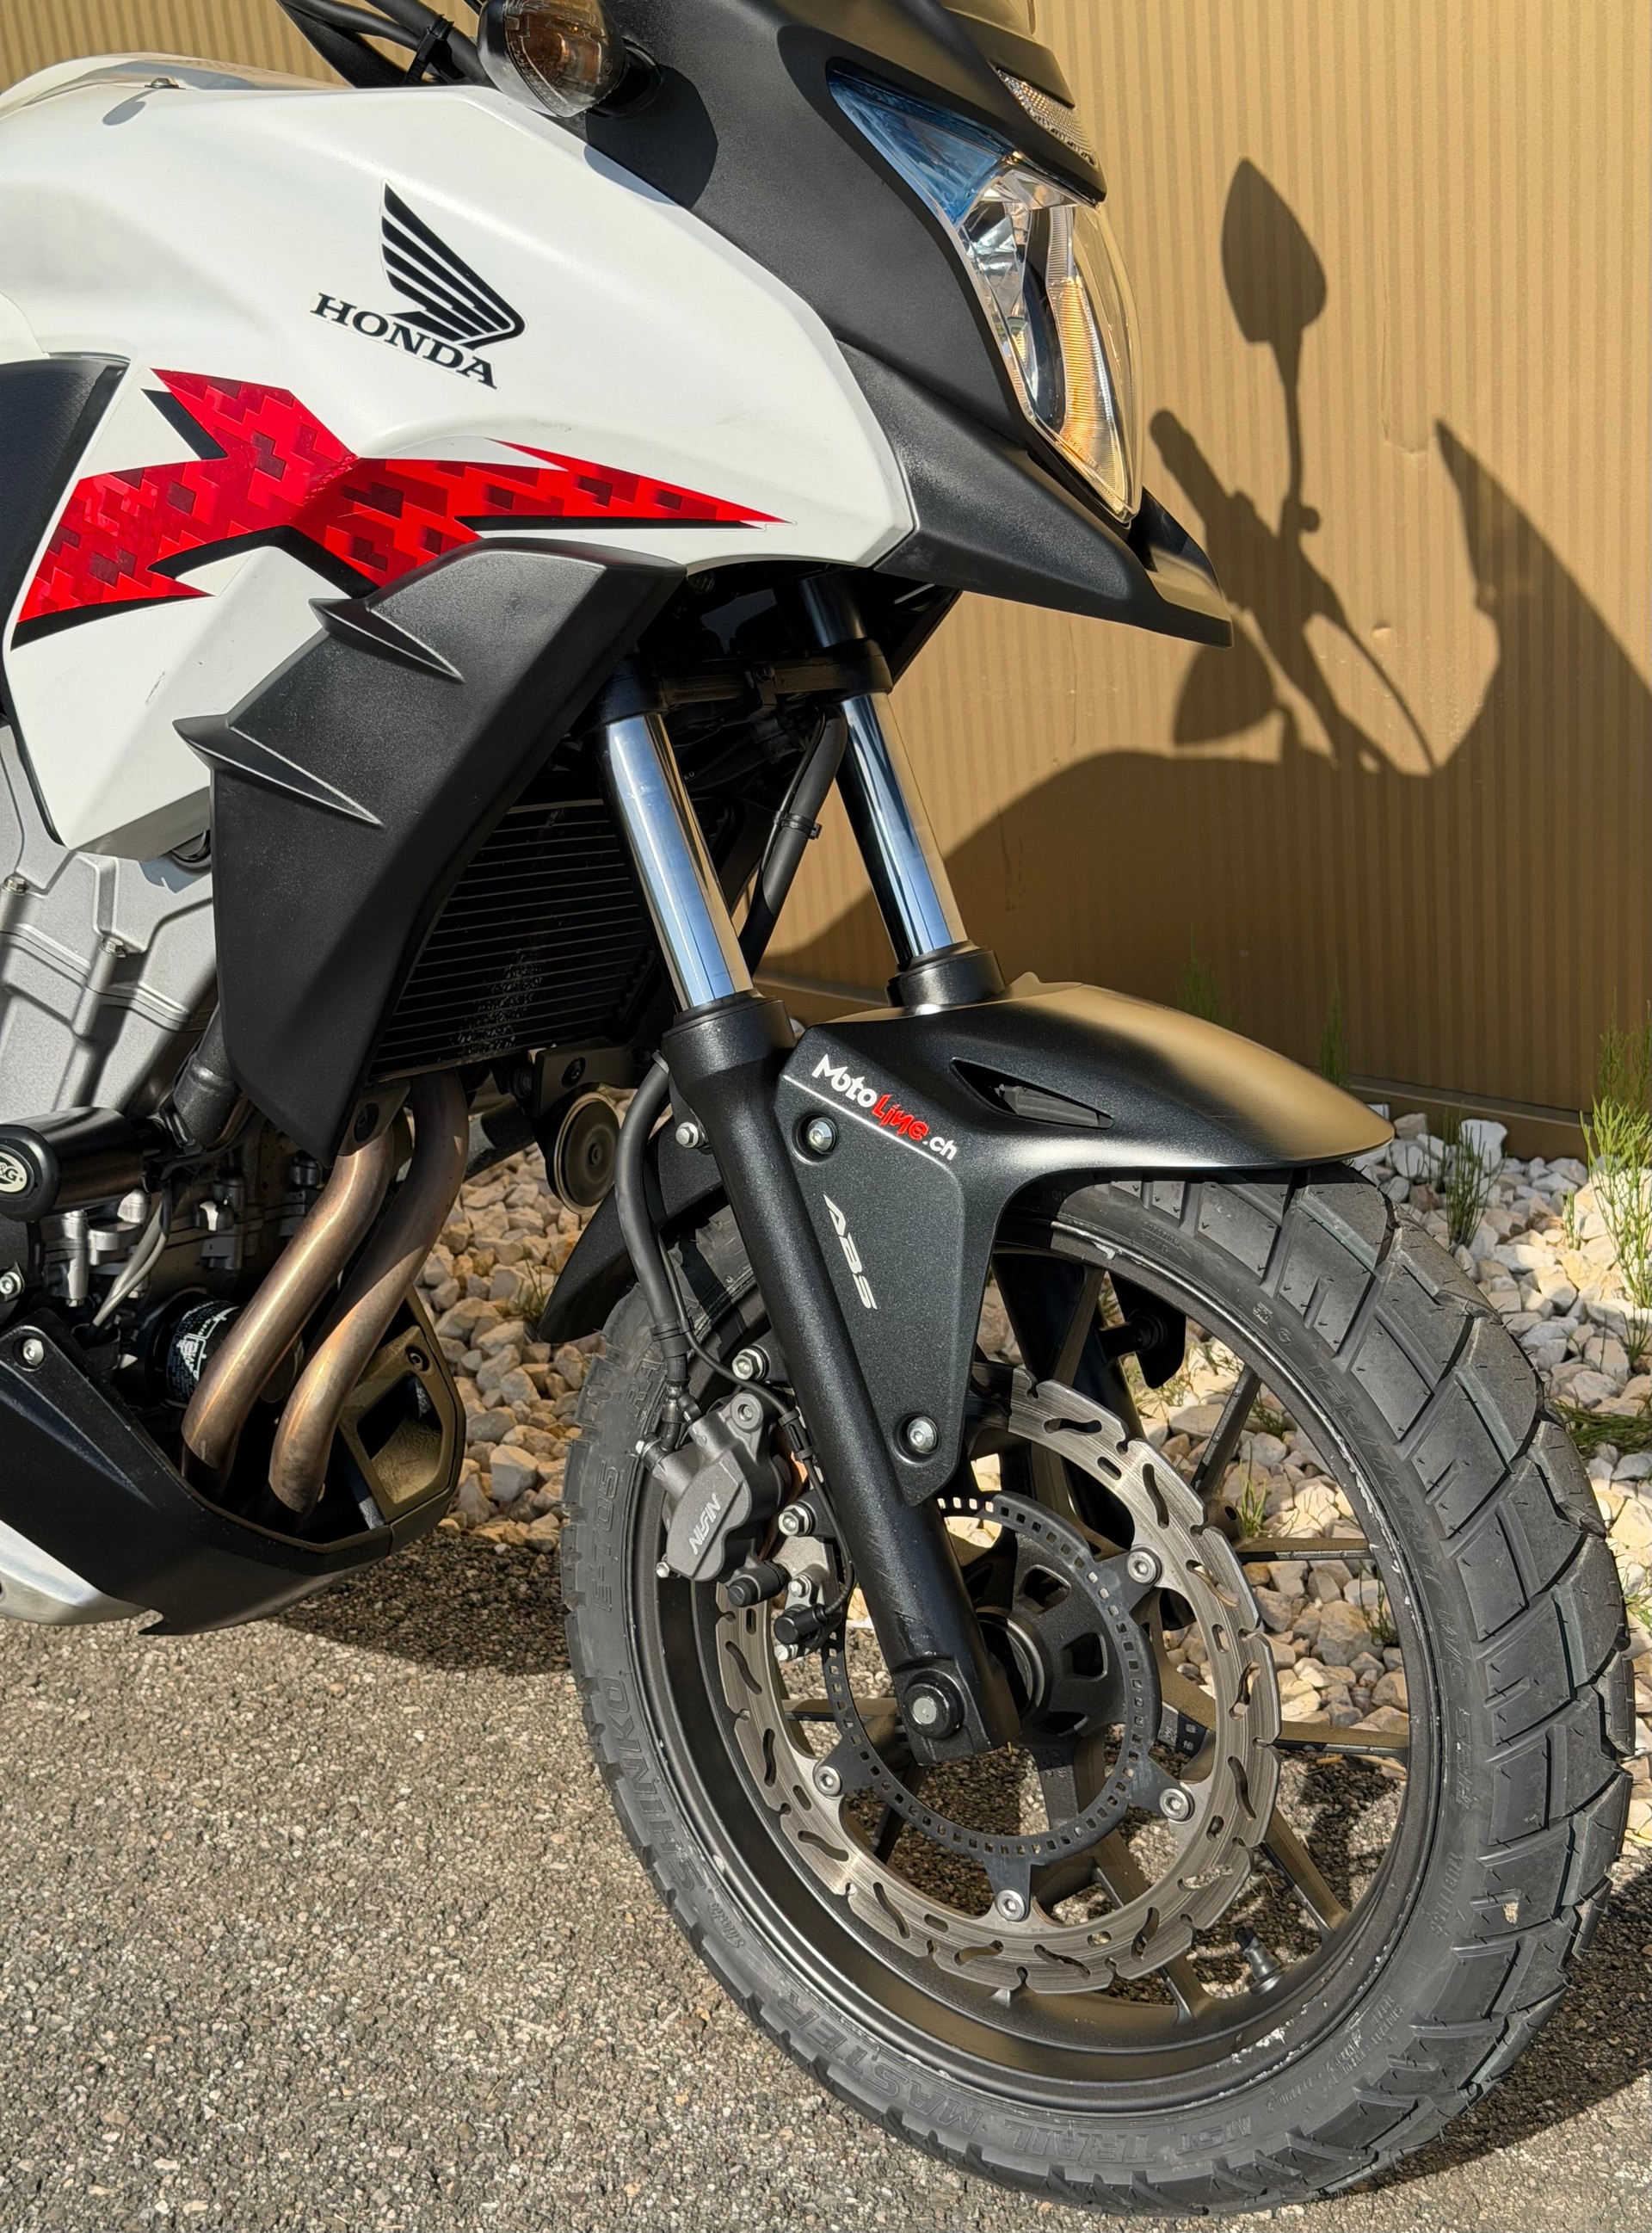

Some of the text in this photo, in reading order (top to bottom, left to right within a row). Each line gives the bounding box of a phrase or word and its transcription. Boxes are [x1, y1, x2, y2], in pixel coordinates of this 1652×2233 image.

[310, 293, 498, 390] HONDA
[812, 1053, 958, 1161] MotoLine.ch
[823, 1194, 878, 1310] ABS
[592, 1459, 620, 1613] E-705
[604, 1677, 706, 1892] SHINKO
[776, 1989, 1157, 2162] TRAIL MASTER
